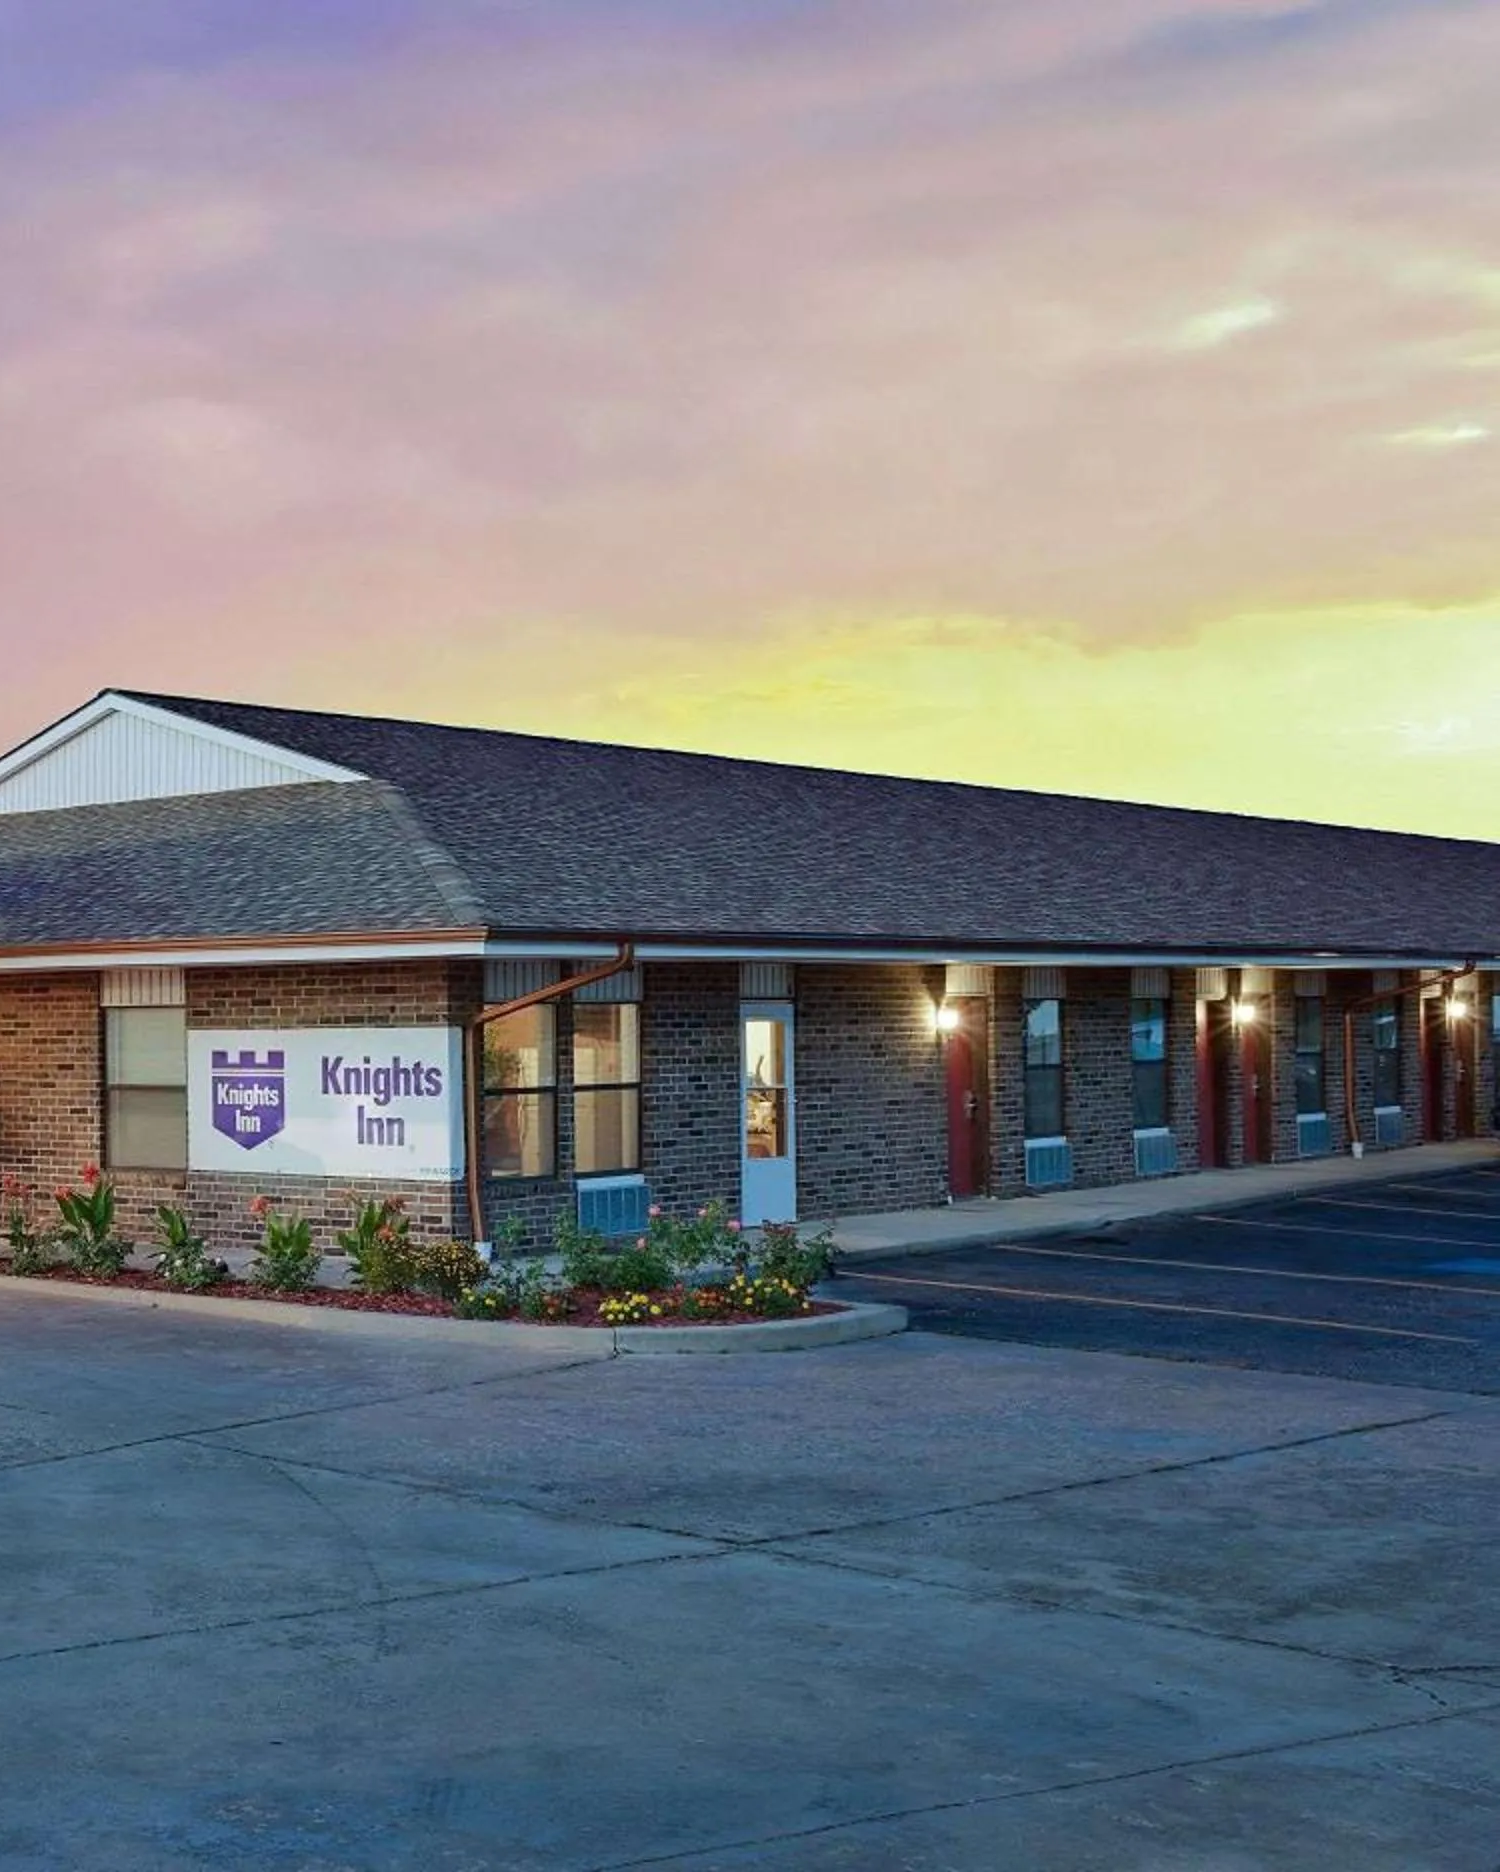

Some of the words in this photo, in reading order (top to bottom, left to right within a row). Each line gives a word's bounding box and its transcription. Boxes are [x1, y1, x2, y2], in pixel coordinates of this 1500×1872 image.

[217, 1083, 279, 1110] Knights
[321, 1056, 443, 1105] Knights
[235, 1110, 261, 1133] Inn
[357, 1105, 405, 1146] Inn
